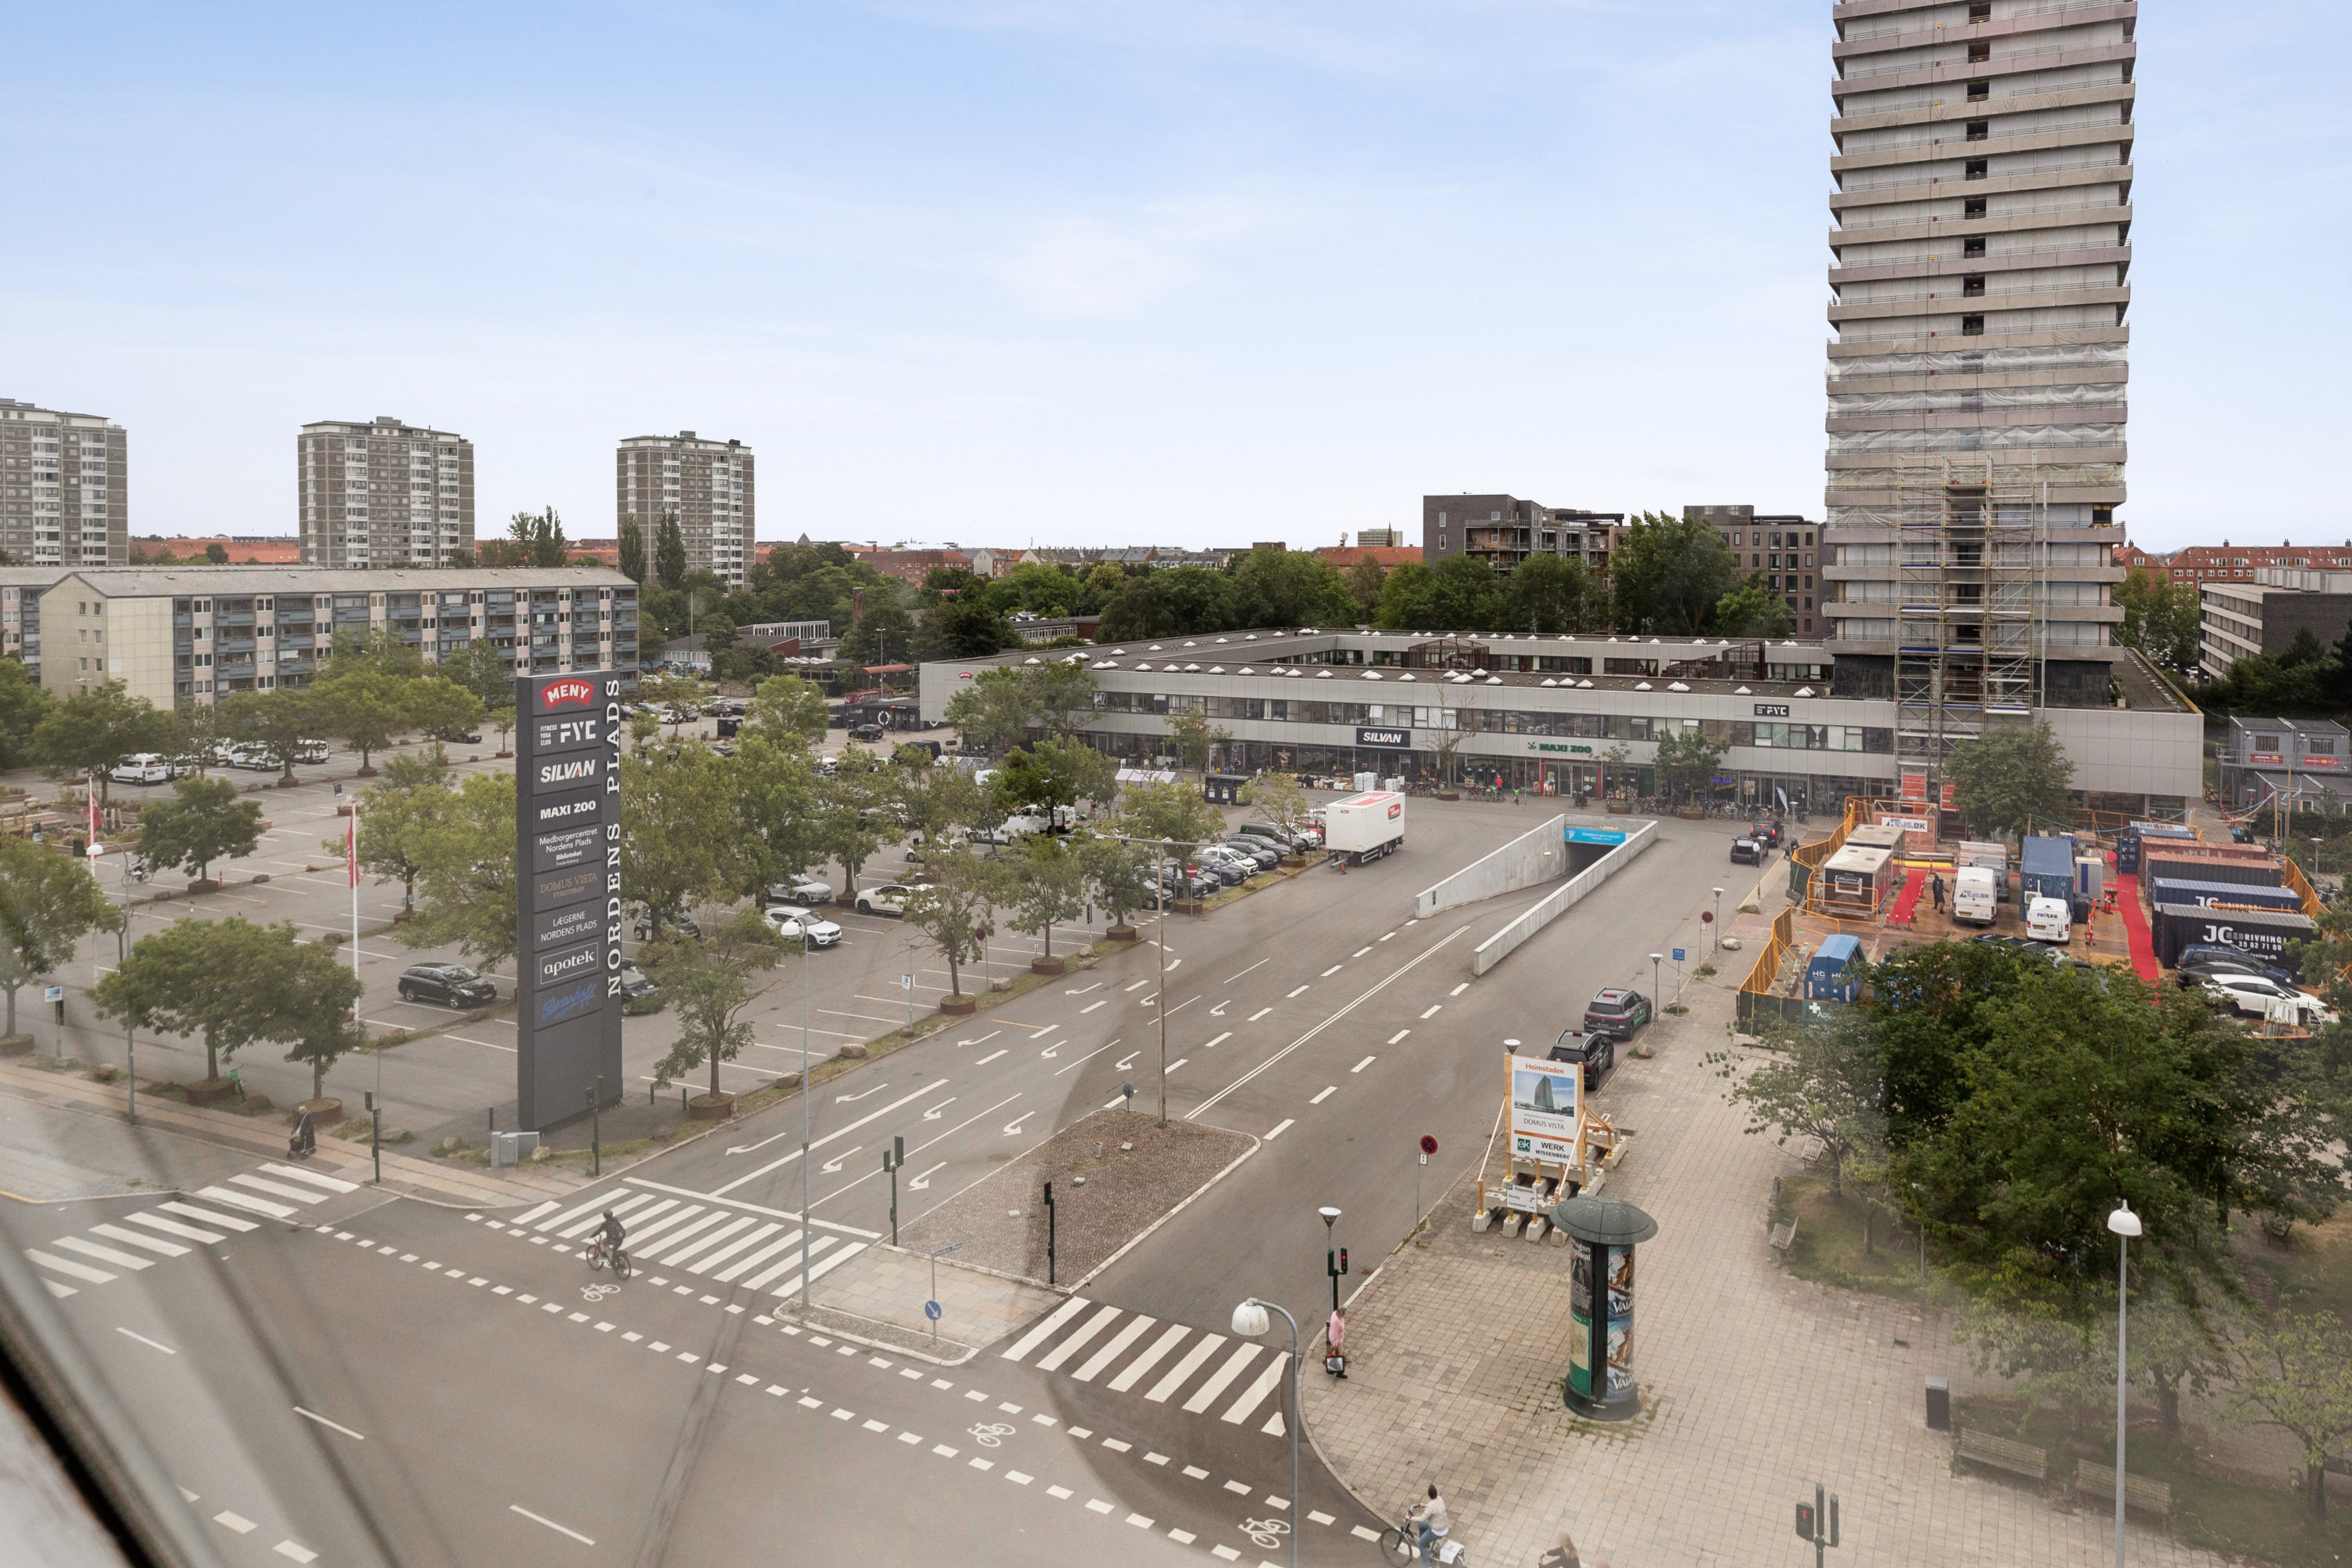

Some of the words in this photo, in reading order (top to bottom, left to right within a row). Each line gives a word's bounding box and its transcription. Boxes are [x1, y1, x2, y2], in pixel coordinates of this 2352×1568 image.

[547, 684, 589, 703] MENY
[1766, 706, 1787, 715] FYC
[560, 720, 597, 743] FYC
[606, 680, 619, 794] PLADS
[1363, 731, 1402, 743] SILVAN
[1539, 743, 1568, 752] MAXI
[1570, 745, 1592, 753] ZOO
[540, 759, 596, 782] SILVAN
[540, 804, 571, 819] MAXI
[573, 800, 597, 813] ZOO
[539, 828, 598, 845] Medborgercentret
[546, 842, 573, 853] Nordens
[575, 837, 592, 847] Plads
[556, 851, 583, 861] Biblioteket
[539, 878, 572, 894] DOMUS
[574, 872, 598, 885] VISTA
[554, 886, 585, 898] FYSIOTERAPI
[553, 911, 586, 927] LÆGERNE
[607, 823, 621, 999] NORDENS
[541, 927, 575, 942] NORDENS
[575, 920, 597, 933] PLADS
[2203, 924, 2234, 944] JC
[544, 950, 596, 976] apotek
[1526, 1062, 1565, 1075] Heimstaden
[1523, 1117, 1547, 1127] DOMUS
[1518, 1138, 1530, 1149] ek
[1541, 1142, 1565, 1152] WERK
